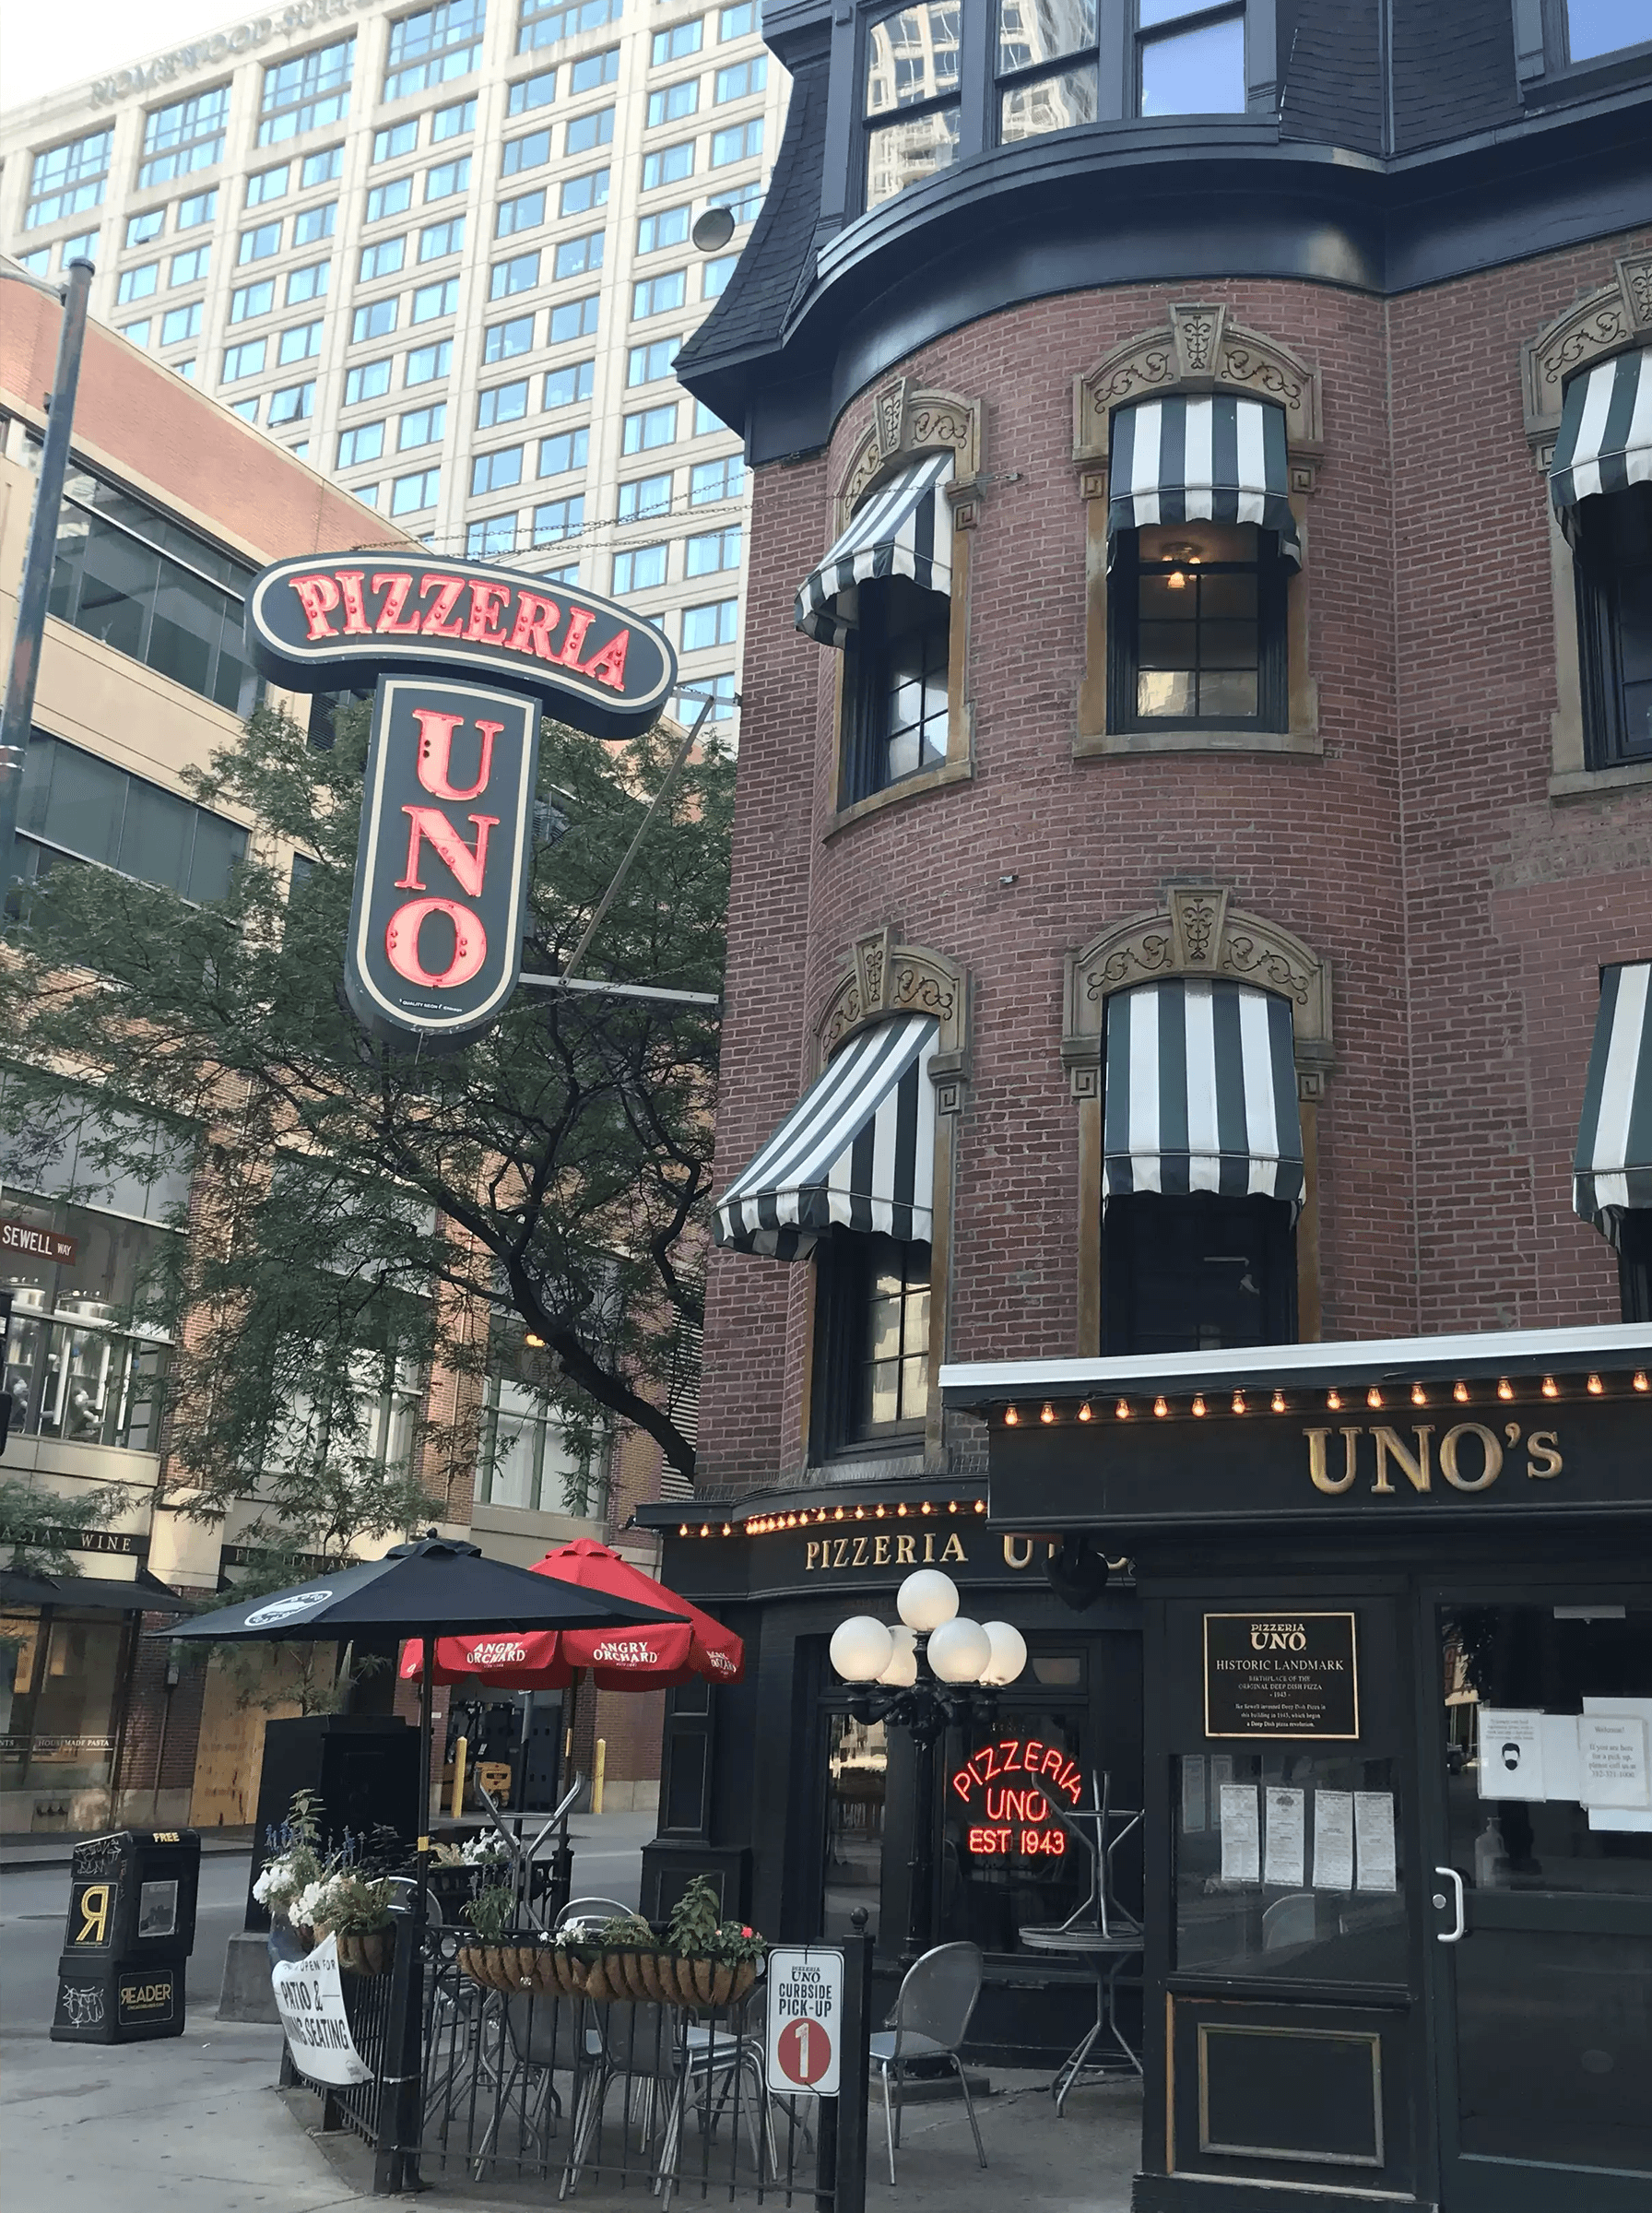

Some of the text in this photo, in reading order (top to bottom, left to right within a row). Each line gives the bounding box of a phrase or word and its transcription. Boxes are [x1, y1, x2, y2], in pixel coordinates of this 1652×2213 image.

[289, 571, 630, 691] PIZZERIA
[385, 709, 504, 988] UNO
[2, 1225, 72, 1256] SEWELL WAY
[81, 1533, 132, 1552] WINE
[805, 1533, 969, 1570] PIZZERIA
[473, 1641, 524, 1654] ANGRY
[601, 1641, 648, 1653] ANGRY
[1250, 1631, 1306, 1651] UNO
[466, 1650, 525, 1663] ORCHARD
[593, 1649, 658, 1663] ORCHARD
[1216, 1660, 1343, 1670] HISTORIC LANDMARK
[953, 1741, 1081, 1805] PIZZERIA
[986, 1787, 1047, 1822] UNO
[152, 1832, 180, 1842] FREE
[970, 1828, 1065, 1855] EST 1943
[301, 1959, 321, 1972] OPEN
[323, 1959, 336, 1970] FOR
[791, 1971, 820, 1983] UNO
[280, 1980, 324, 2012] PATIO &
[779, 1982, 832, 2000] CURBSIDE
[779, 1998, 832, 2018] PICK-UP
[305, 2017, 350, 2050] SEATING
[795, 2022, 809, 2078] 1
